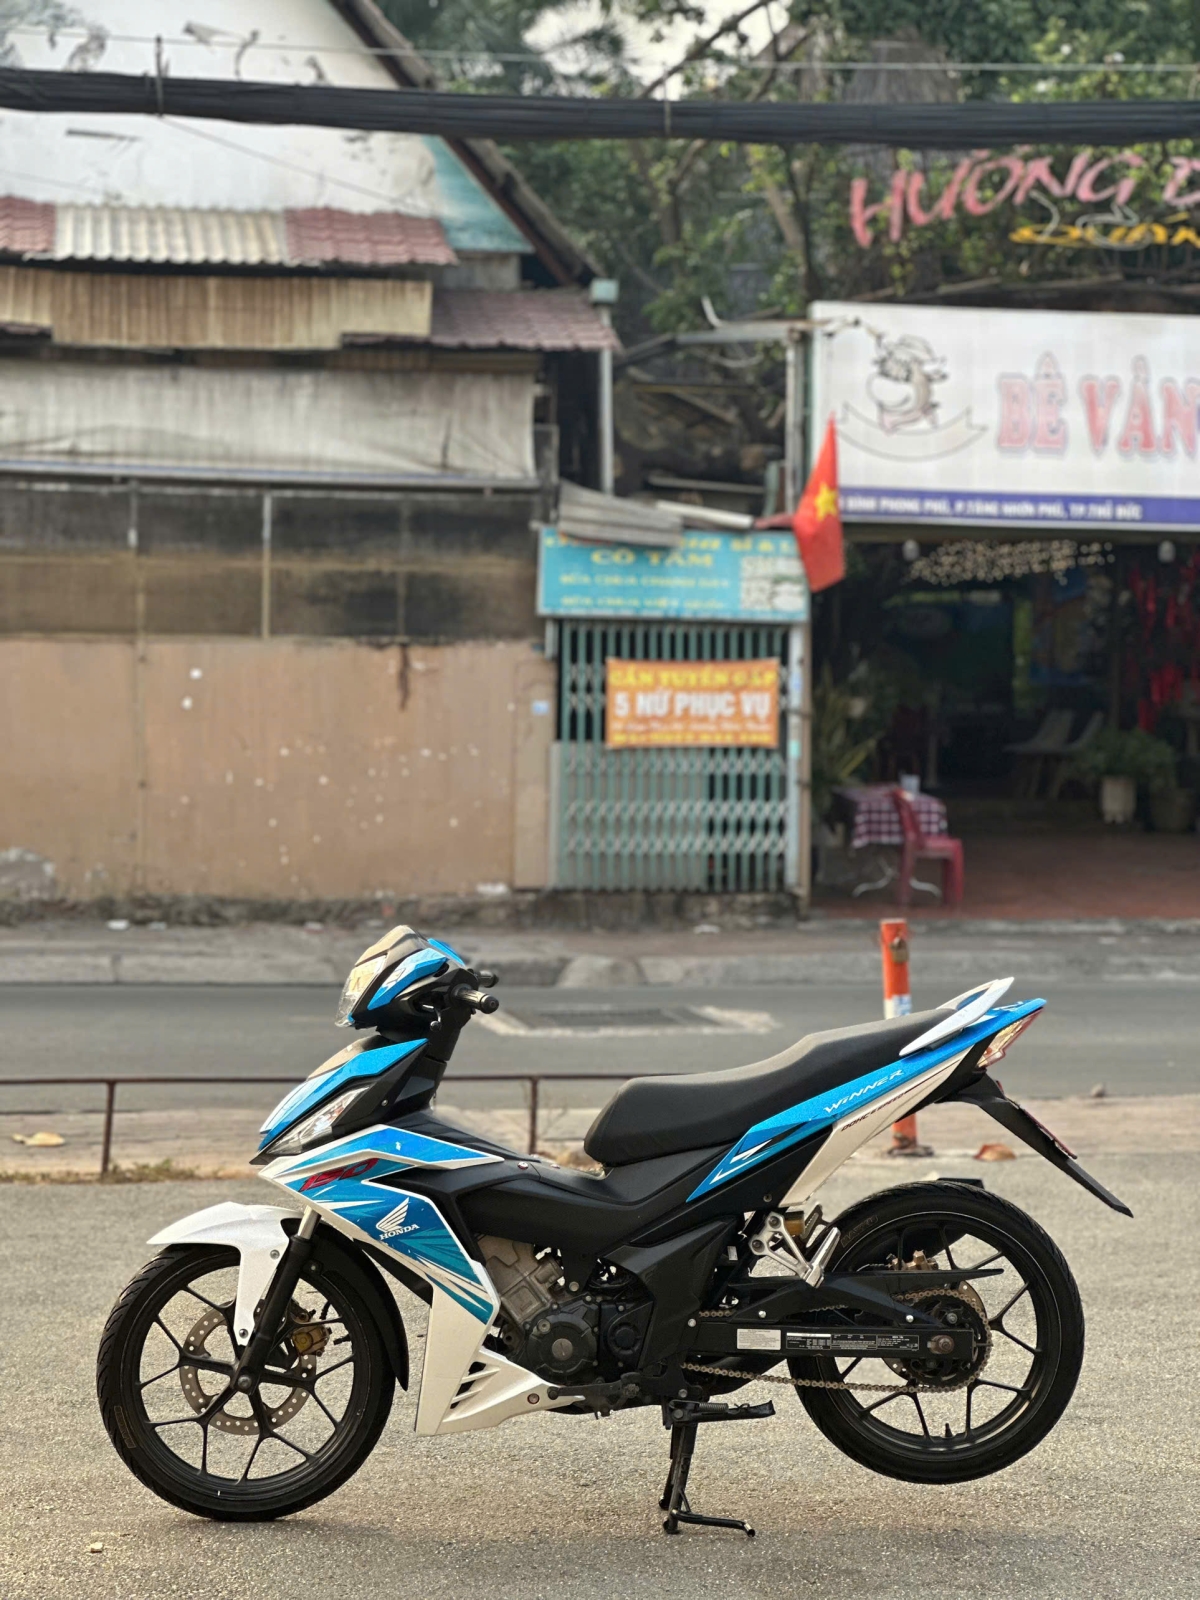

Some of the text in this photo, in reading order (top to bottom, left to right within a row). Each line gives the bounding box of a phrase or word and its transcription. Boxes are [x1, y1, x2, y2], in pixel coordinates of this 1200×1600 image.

[614, 686, 771, 723] 5 NỮ PHỤC VỤ
[379, 1223, 420, 1241] HONDA
